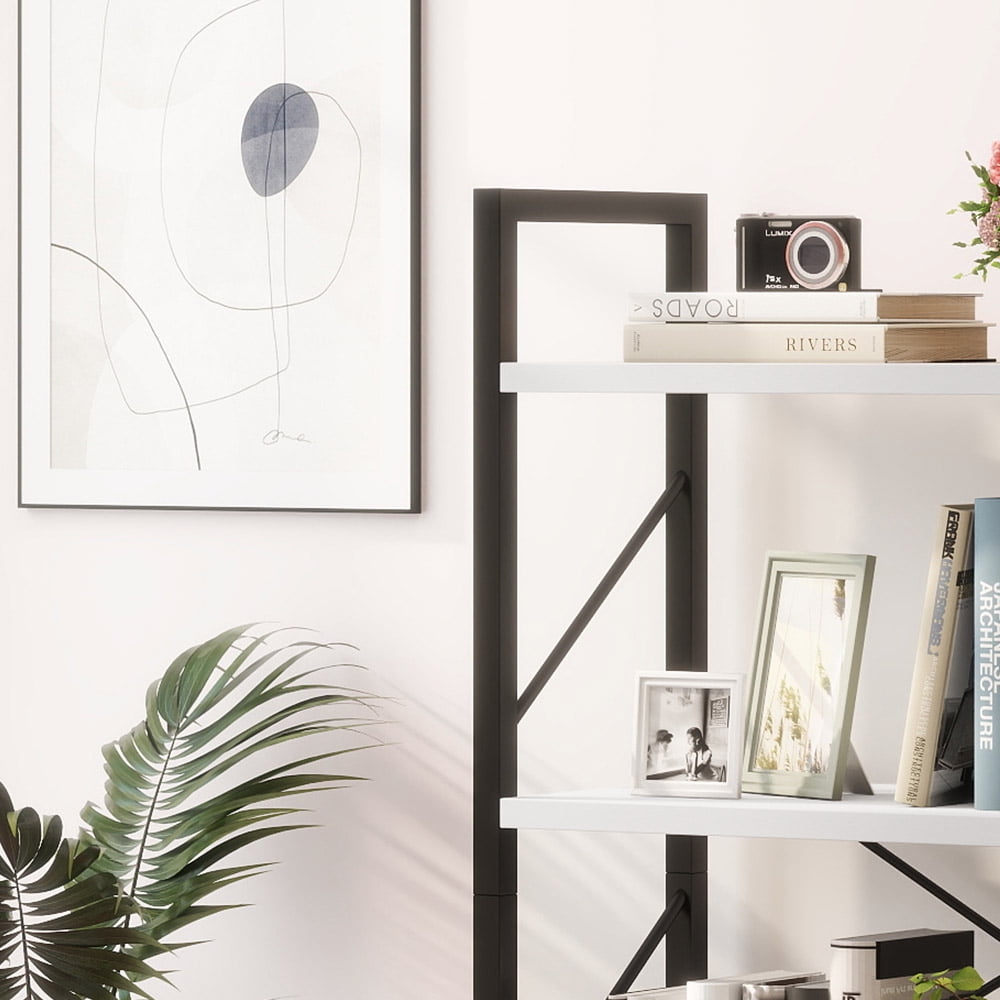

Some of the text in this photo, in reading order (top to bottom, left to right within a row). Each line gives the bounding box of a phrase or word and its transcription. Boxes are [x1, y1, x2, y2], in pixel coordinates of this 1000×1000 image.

[765, 229, 792, 237] LUMIX
[652, 299, 738, 318] ROADS
[785, 337, 858, 353] RIVERS
[979, 580, 993, 750] ARCHITECTURE
